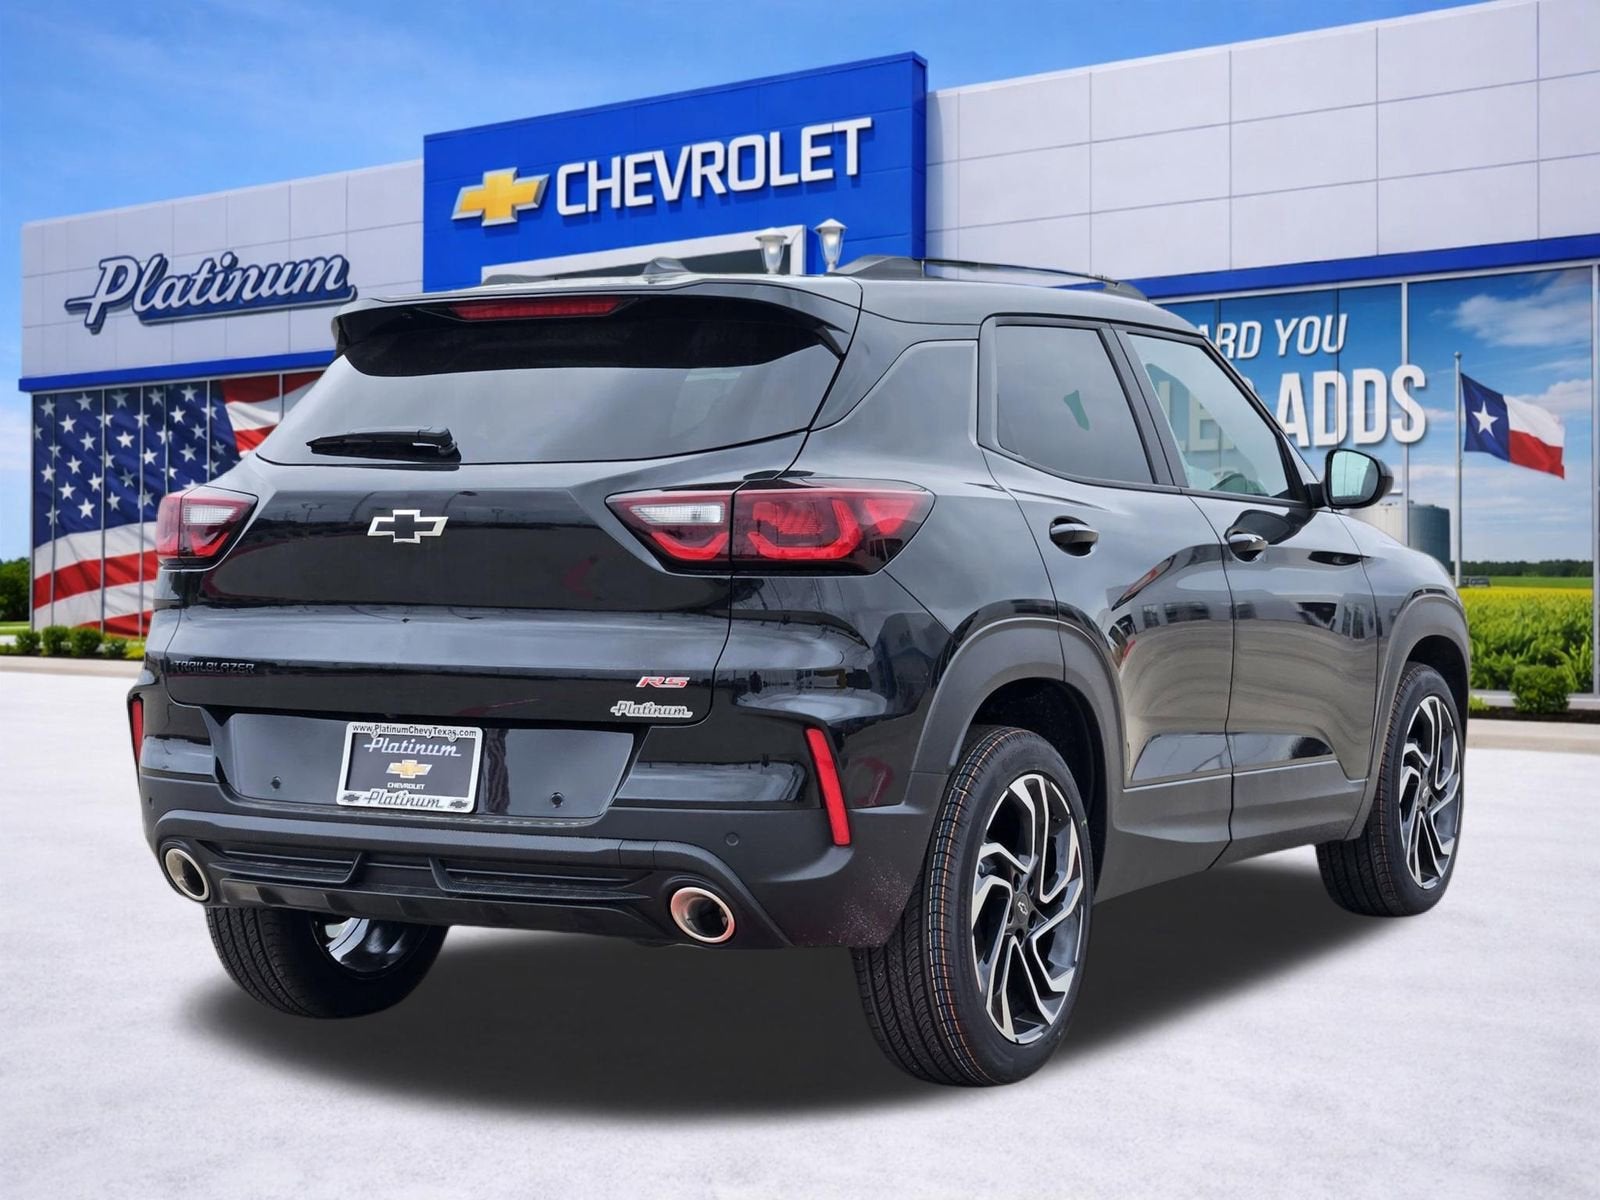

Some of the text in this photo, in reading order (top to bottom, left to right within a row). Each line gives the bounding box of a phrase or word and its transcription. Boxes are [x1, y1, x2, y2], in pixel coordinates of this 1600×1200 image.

[556, 117, 872, 216] CHEVROLET
[64, 251, 358, 334] Platinum
[1274, 313, 1348, 356] YOU
[1276, 364, 1426, 447] ADDS
[174, 660, 255, 674] TRAILBLAZER
[636, 676, 690, 688] RS
[610, 700, 694, 718] Platinum
[352, 724, 477, 737] www.PlatinumChevyTexas.com
[363, 737, 462, 757] Platinum
[387, 782, 426, 790] CHEVROLET
[364, 790, 445, 808] Platinum
